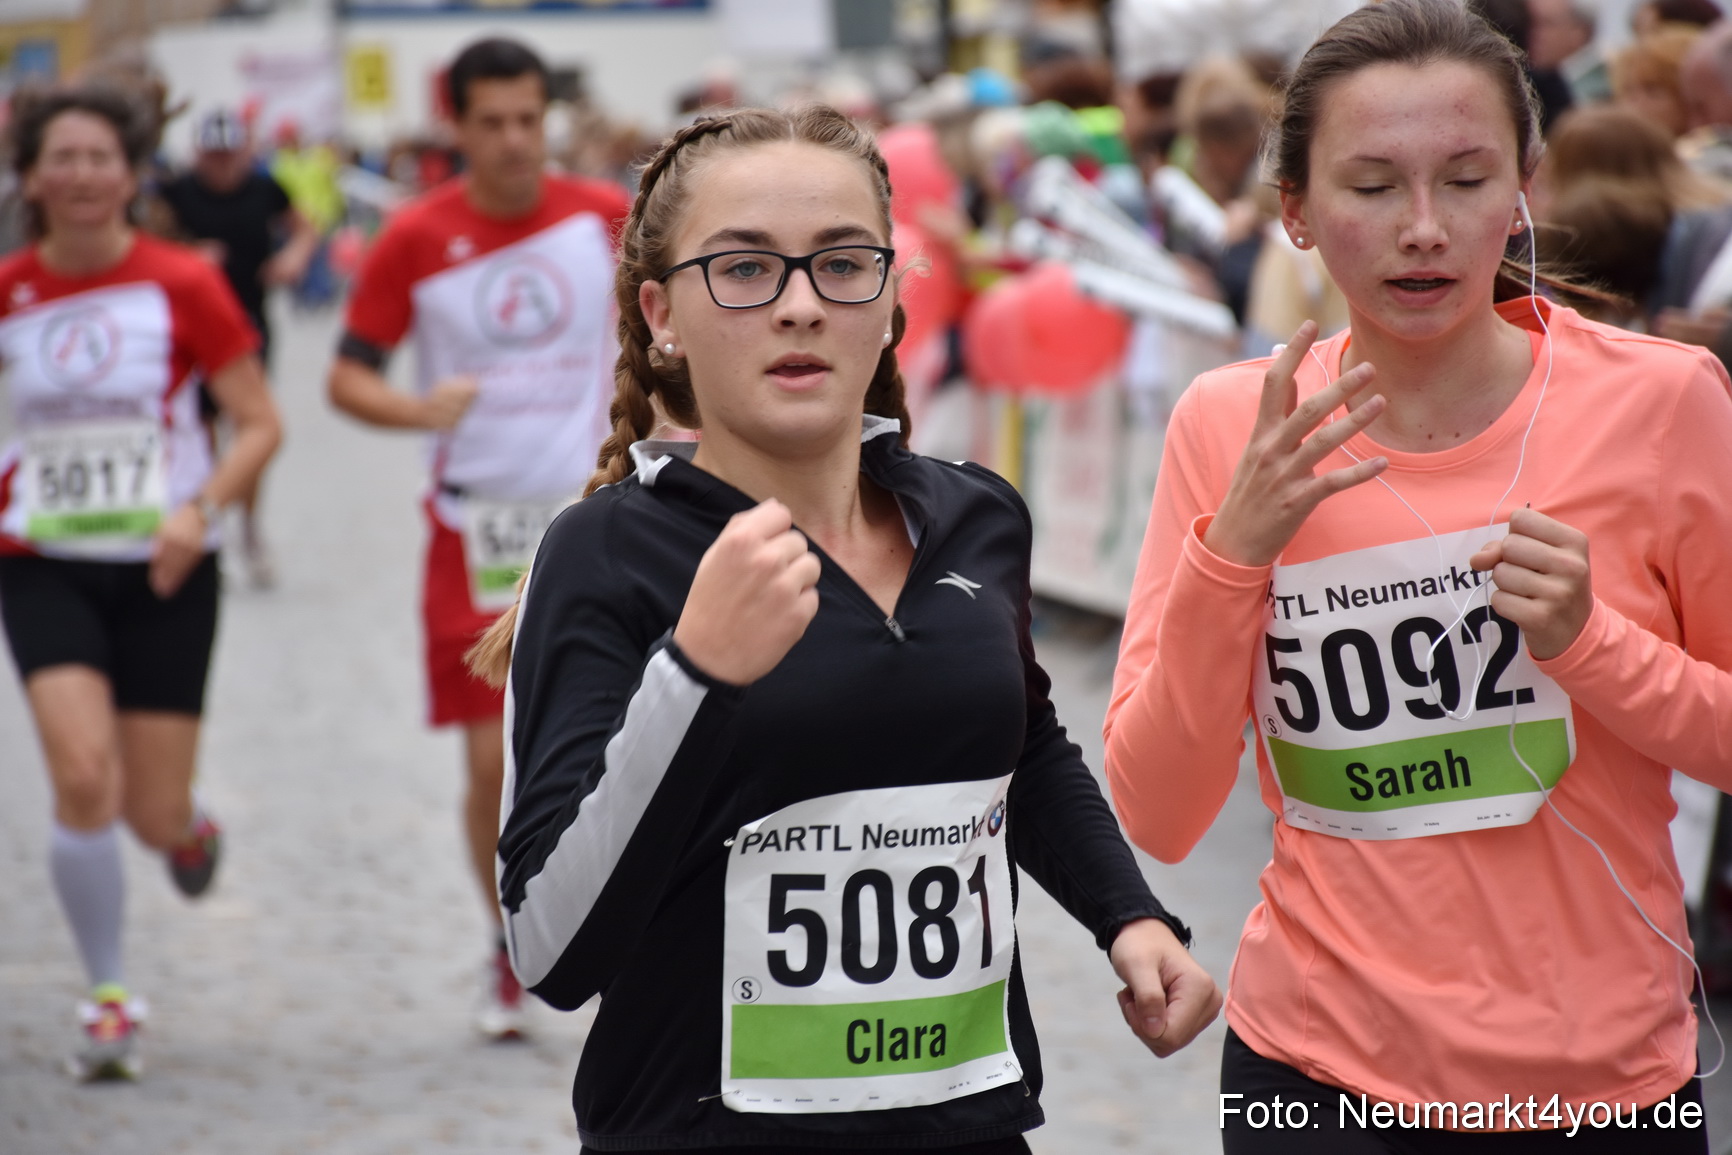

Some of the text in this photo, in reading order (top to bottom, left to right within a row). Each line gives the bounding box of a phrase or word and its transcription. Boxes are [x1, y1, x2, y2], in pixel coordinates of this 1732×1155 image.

[1325, 566, 1482, 612] Neumarkt
[1265, 604, 1535, 733] 5092
[1345, 748, 1472, 801] Sarah
[740, 815, 985, 855] PARTL Neumarkt
[767, 855, 993, 988] 5081
[846, 1018, 947, 1064] Clara
